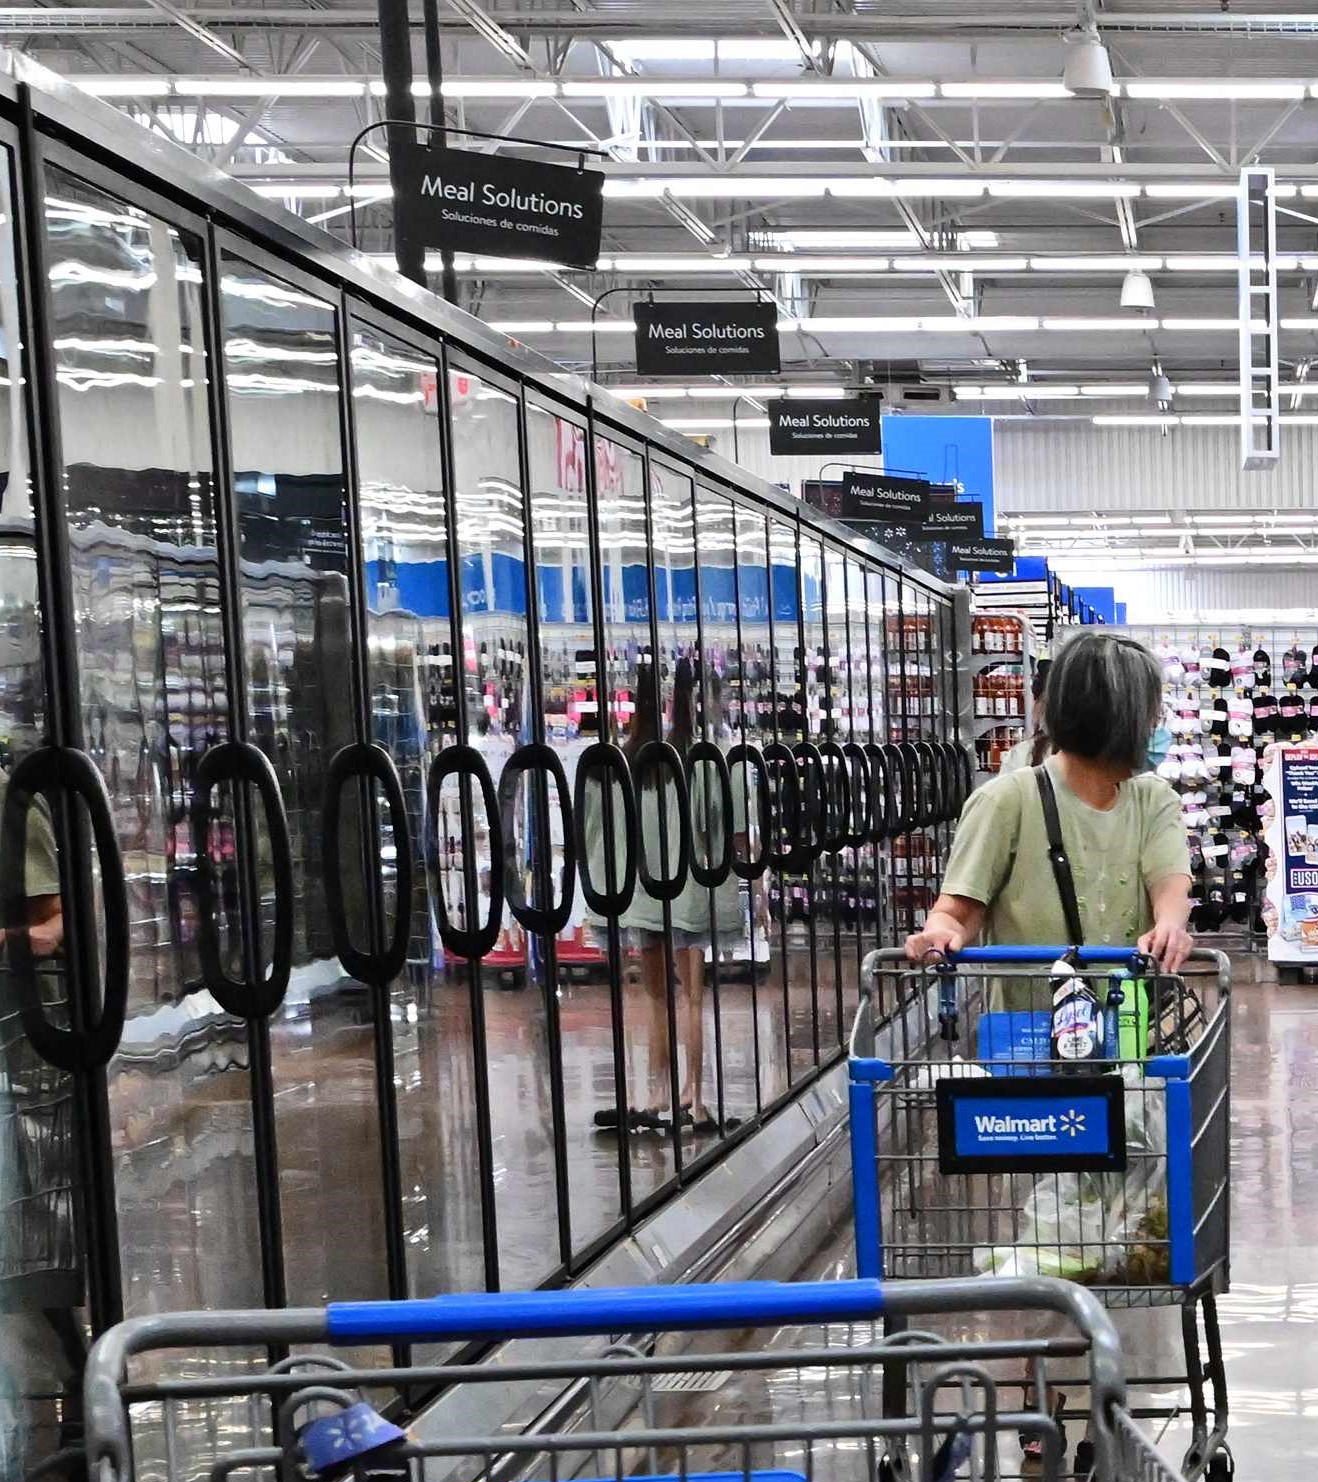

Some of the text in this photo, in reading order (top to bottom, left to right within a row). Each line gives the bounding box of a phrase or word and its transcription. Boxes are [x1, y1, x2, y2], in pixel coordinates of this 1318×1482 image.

[421, 174, 583, 219] Meal Solutions
[442, 209, 560, 237] Soluciones de comidas
[649, 323, 766, 339] Meal Solutions
[779, 414, 870, 428] Meal Solutions
[850, 484, 875, 497] Meal
[877, 486, 921, 503] Solutions
[936, 513, 976, 523] Solutions
[952, 545, 1008, 557] Meal Solutions
[1298, 870, 1318, 886] USO
[975, 1115, 1057, 1133] Walmart
